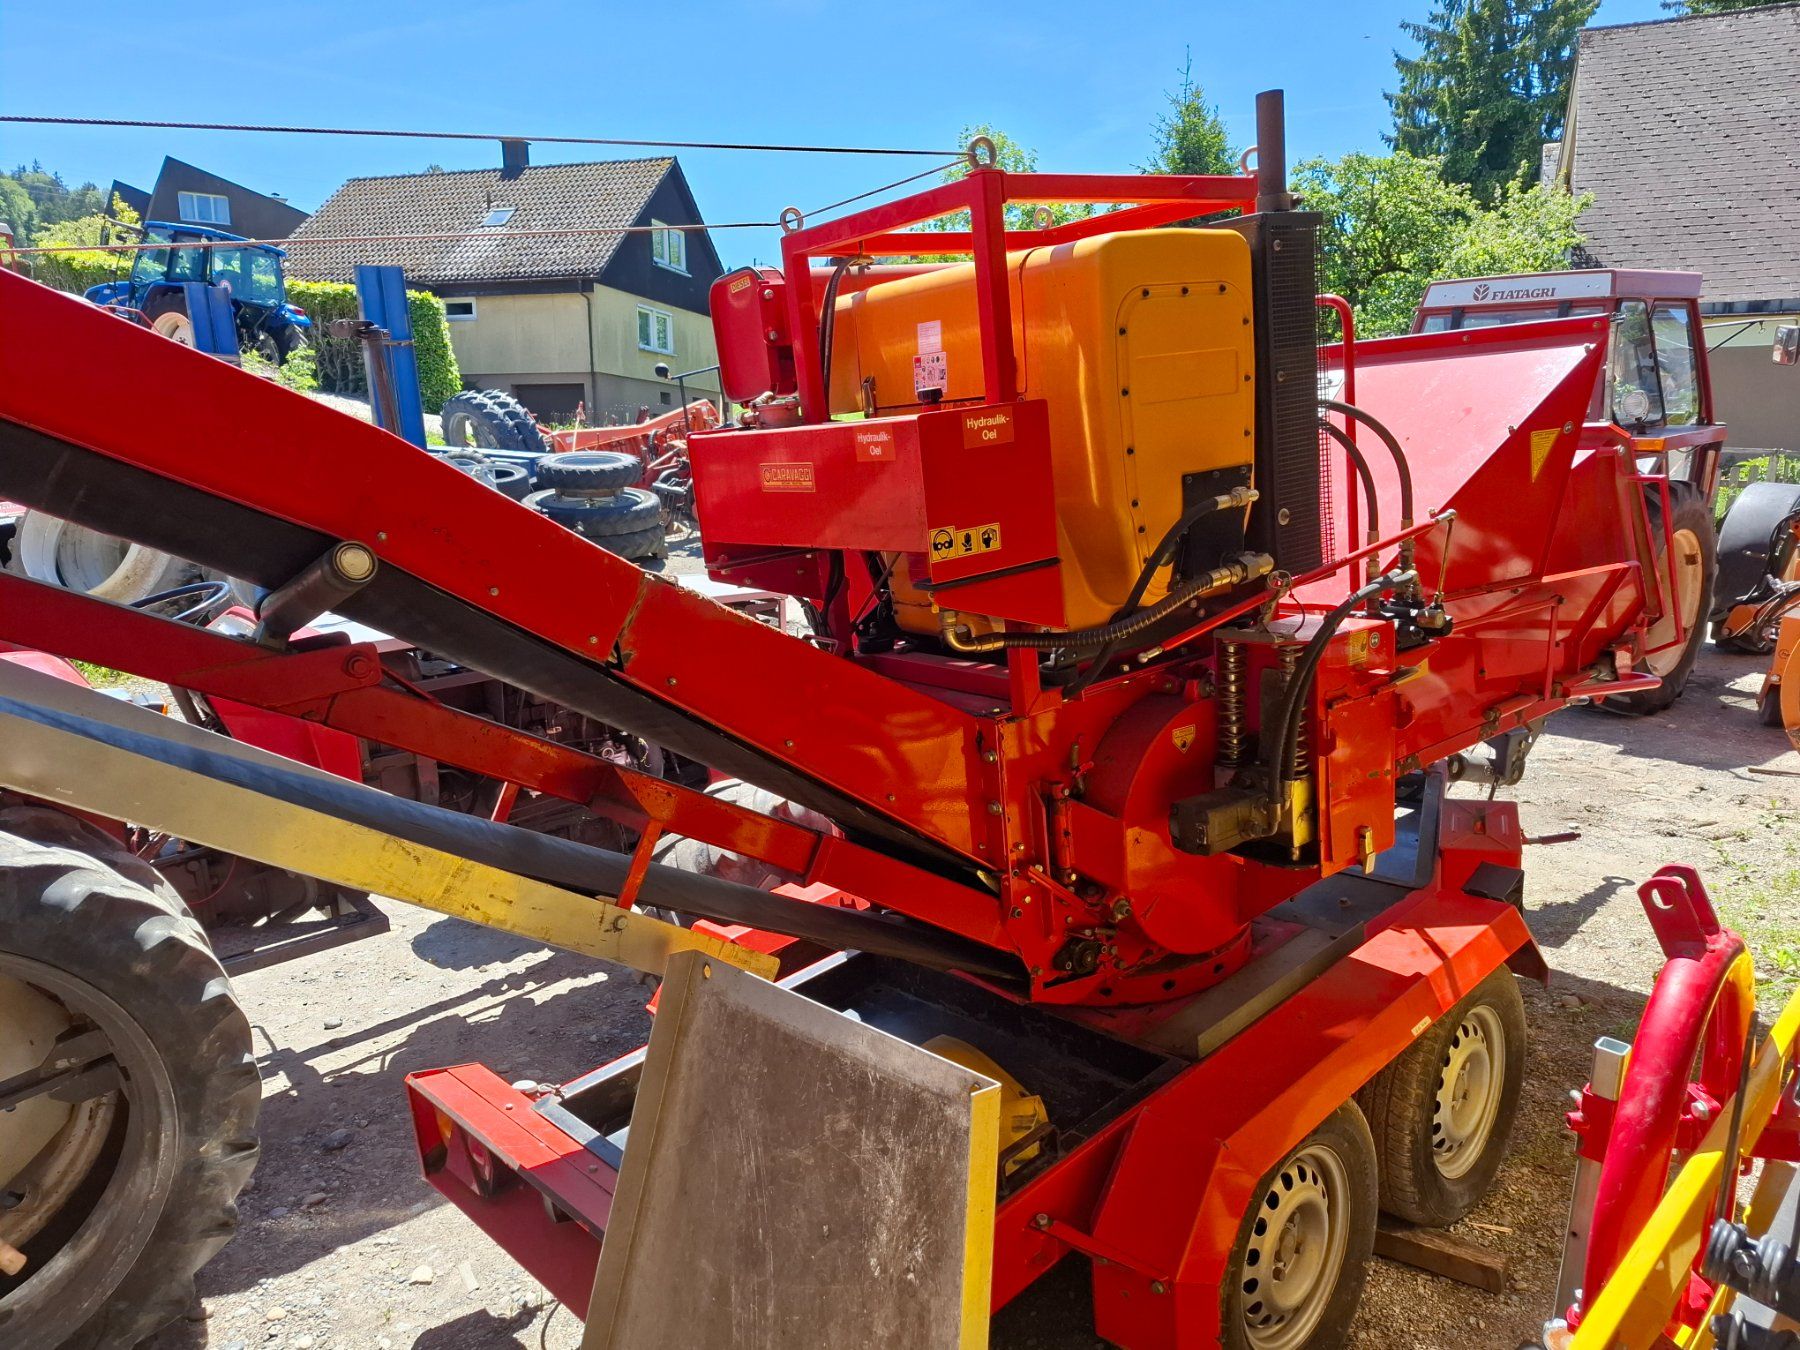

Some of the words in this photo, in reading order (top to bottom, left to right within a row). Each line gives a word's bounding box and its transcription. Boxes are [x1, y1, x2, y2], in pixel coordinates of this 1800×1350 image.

[732, 277, 750, 291] DIESEL
[1491, 287, 1556, 300] FIATAGRI
[967, 414, 1010, 430] Hydraulik-
[857, 432, 891, 443] Hydraulik-
[982, 429, 997, 440] Oel
[869, 446, 882, 456] Oel
[772, 467, 812, 481] CARAVAGGI
